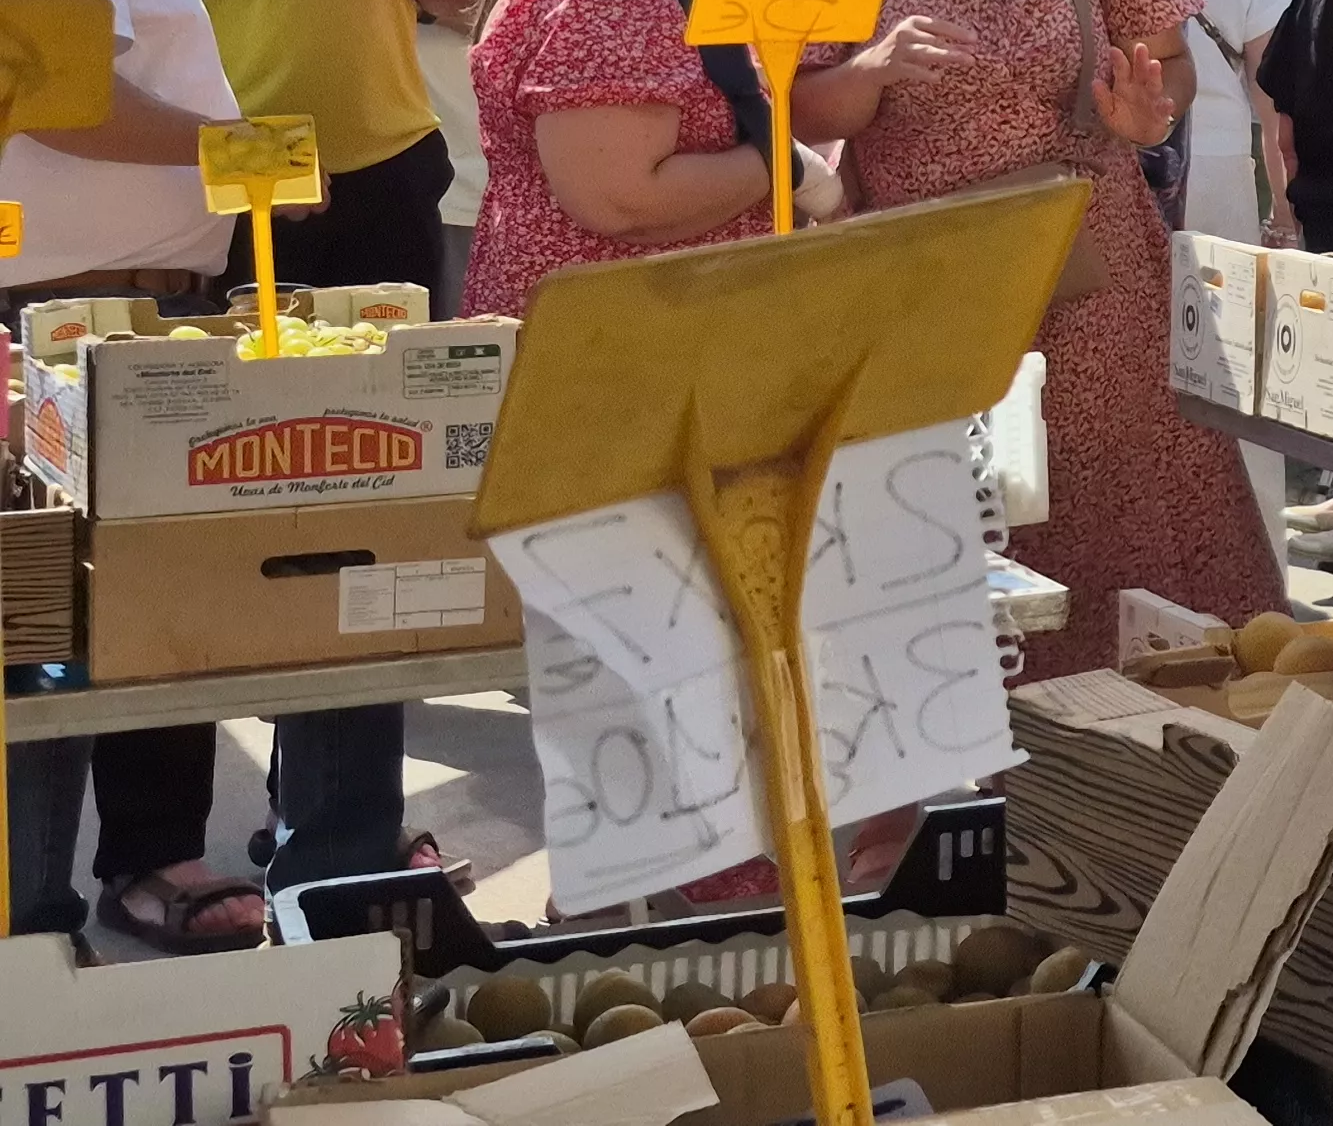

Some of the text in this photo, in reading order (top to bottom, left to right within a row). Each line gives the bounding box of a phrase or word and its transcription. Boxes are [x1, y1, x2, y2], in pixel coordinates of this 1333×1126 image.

[195, 423, 416, 482] MONTECID
[230, 474, 396, 497] Uvas de Monforte del Cid
